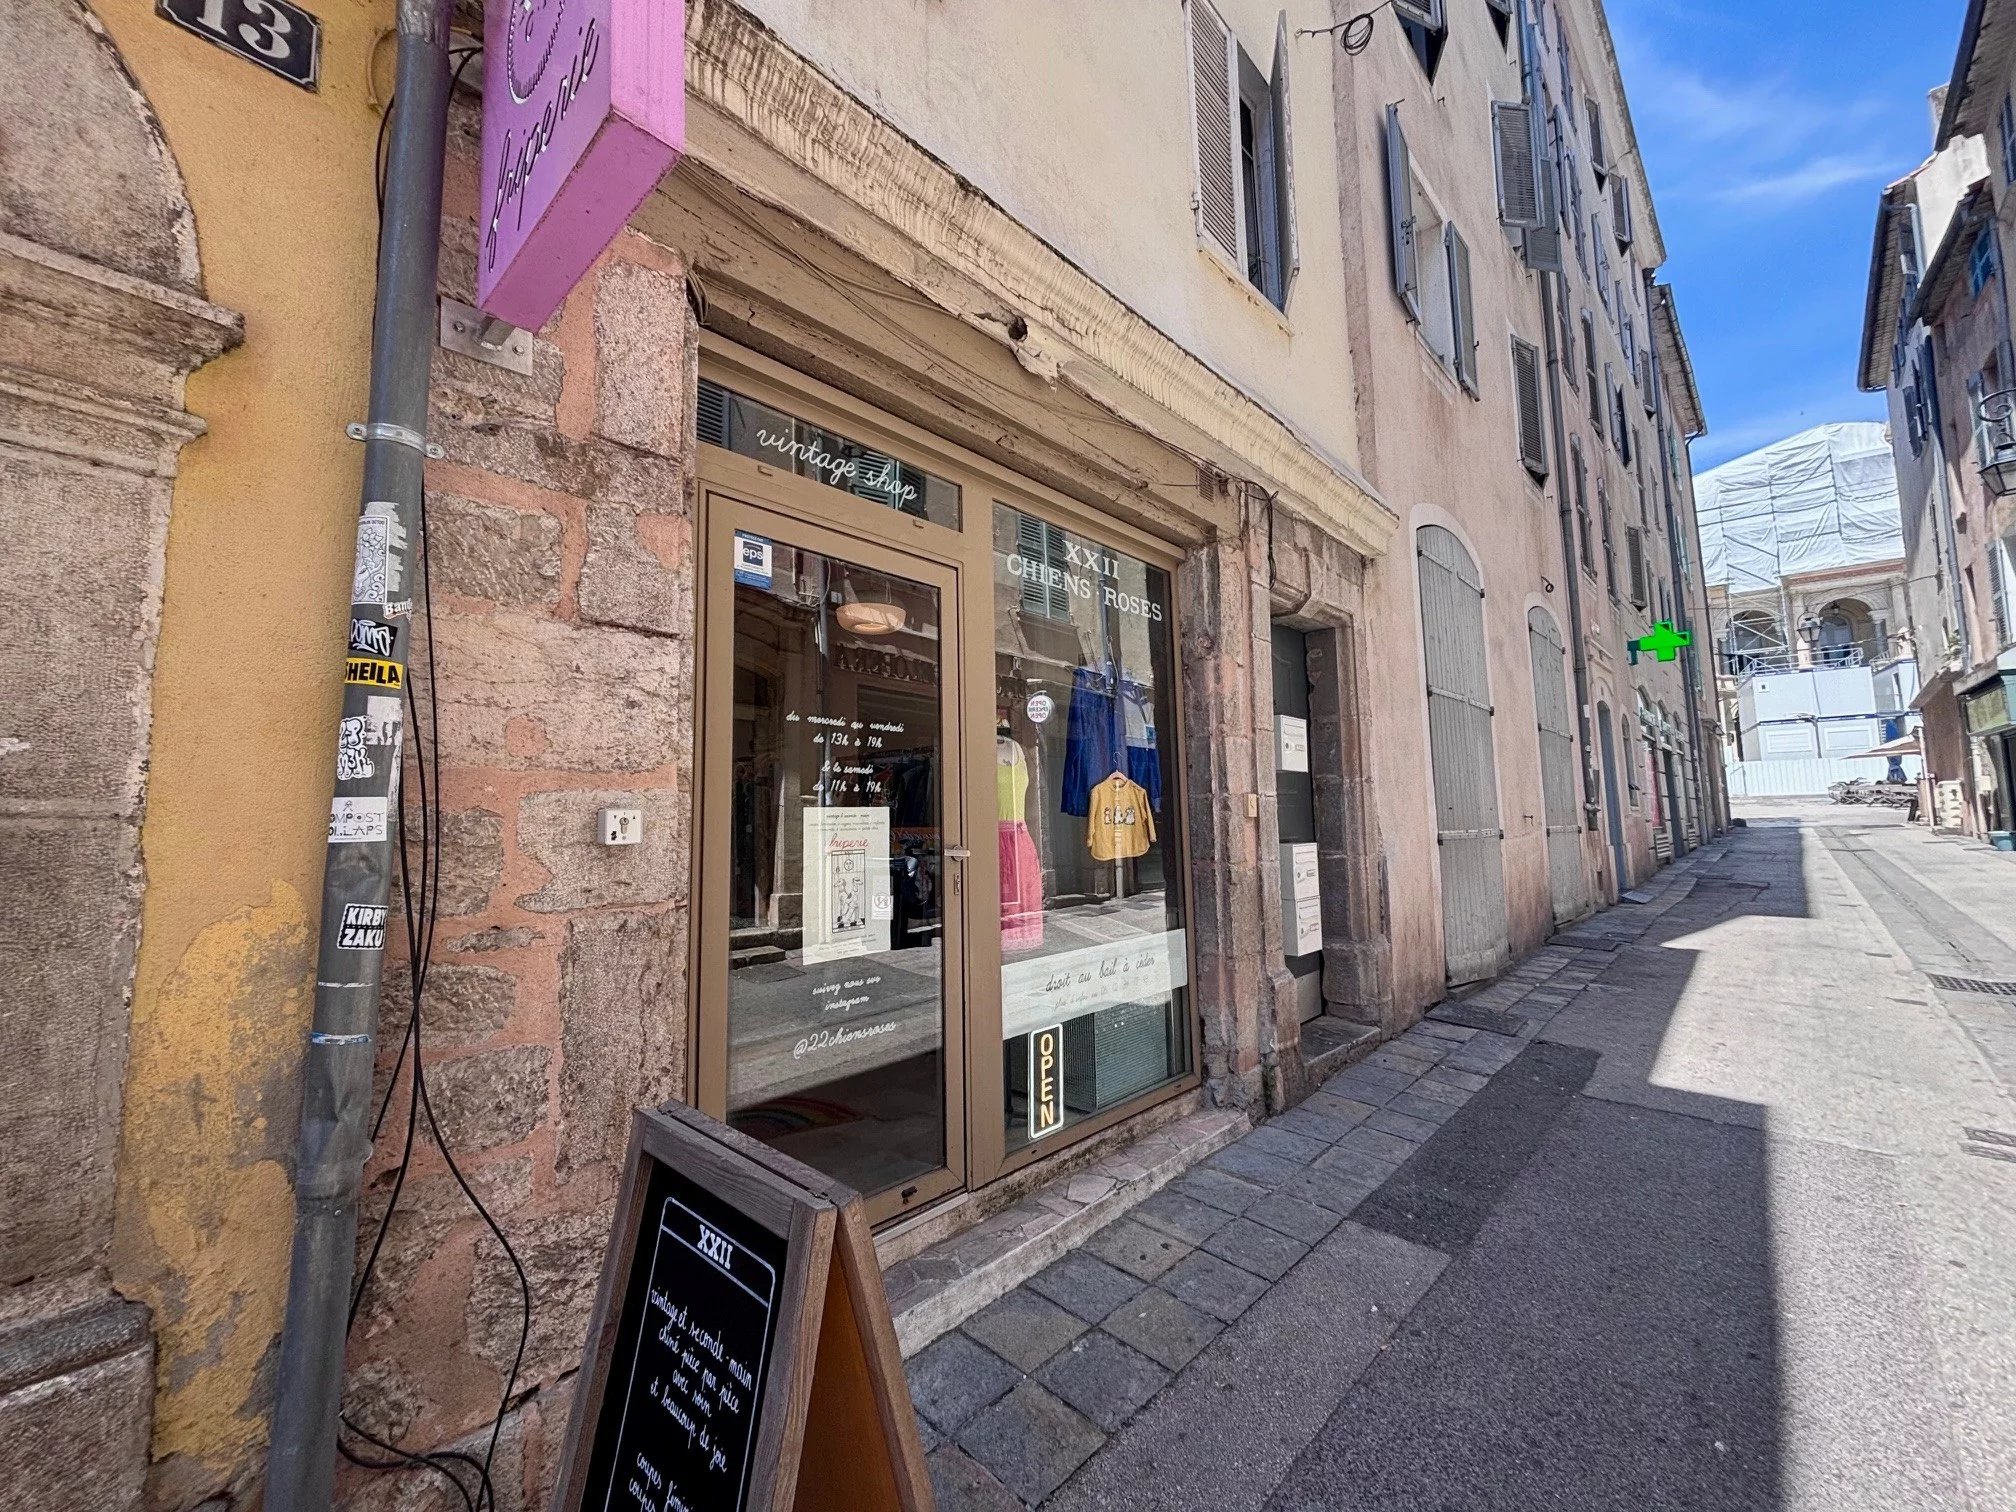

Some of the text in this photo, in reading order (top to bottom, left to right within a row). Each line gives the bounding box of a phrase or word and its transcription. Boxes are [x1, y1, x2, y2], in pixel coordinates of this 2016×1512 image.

[197, 0, 291, 58] 13
[486, 18, 599, 273] friperie
[757, 428, 918, 508] vintage shop
[742, 547, 764, 560] eps
[1062, 540, 1120, 580] XXII
[1007, 554, 1162, 622] CHIENS ROSES
[385, 600, 412, 615] Ban
[345, 662, 400, 684] HEILA
[807, 716, 846, 727] mercredi
[870, 723, 905, 733] vendredi
[831, 732, 849, 747] 13h
[867, 736, 882, 748] 19h
[844, 764, 874, 775] samedi
[831, 779, 847, 792] 11h
[865, 780, 882, 793] 19h
[330, 813, 385, 823] OMPOST
[346, 907, 388, 926] KIRBY
[342, 928, 384, 947] ZAKU
[844, 979, 864, 989] nous
[1045, 973, 1071, 992] droit
[1078, 972, 1092, 985] au
[1099, 957, 1118, 979] bail
[825, 995, 870, 1011] instagram
[793, 1021, 897, 1060] @22chiensroses
[1040, 1033, 1054, 1128] OPEN
[697, 1224, 733, 1269] XXII
[650, 1286, 678, 1330] vintage
[678, 1306, 688, 1330] et
[672, 1369, 712, 1418] avec soin
[701, 1368, 717, 1392] par
[650, 1376, 727, 1473] et beaucoup de joie
[637, 1452, 662, 1491] coupes
